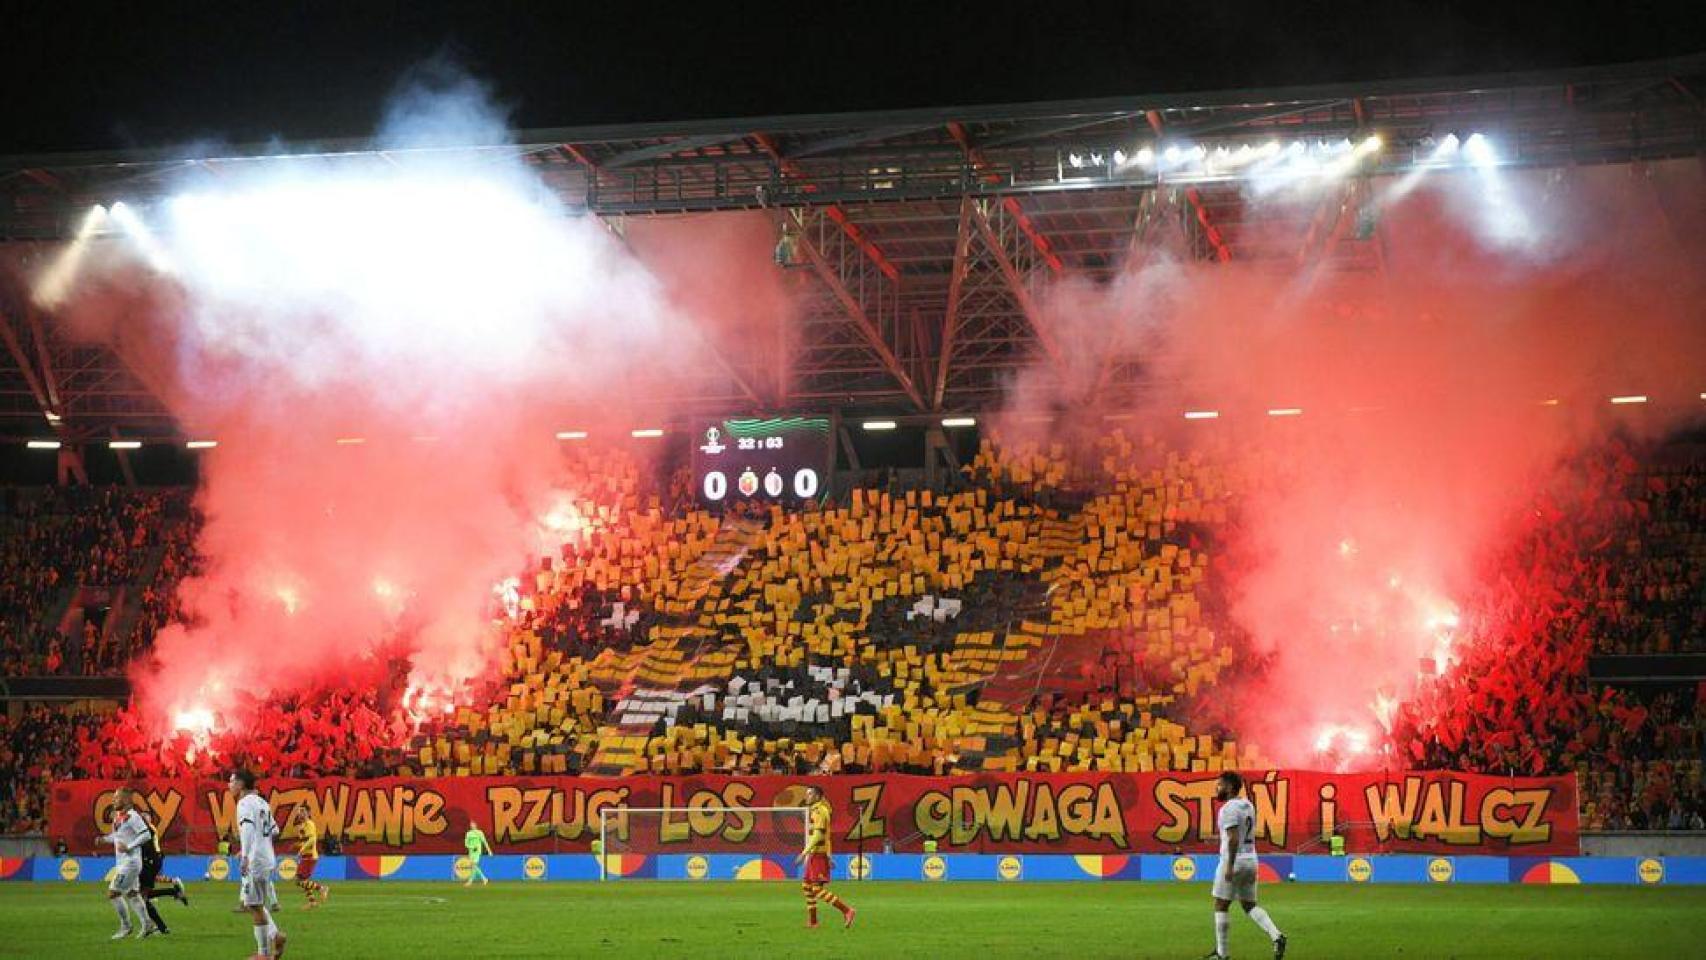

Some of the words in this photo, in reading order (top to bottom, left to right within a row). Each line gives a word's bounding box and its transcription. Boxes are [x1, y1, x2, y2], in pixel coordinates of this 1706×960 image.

[704, 471, 727, 500] 0
[795, 468, 818, 498] 0
[658, 781, 756, 844] LOS
[845, 781, 885, 841] Z
[1153, 769, 1290, 849] STŃ
[1365, 776, 1554, 845] WALCZ
